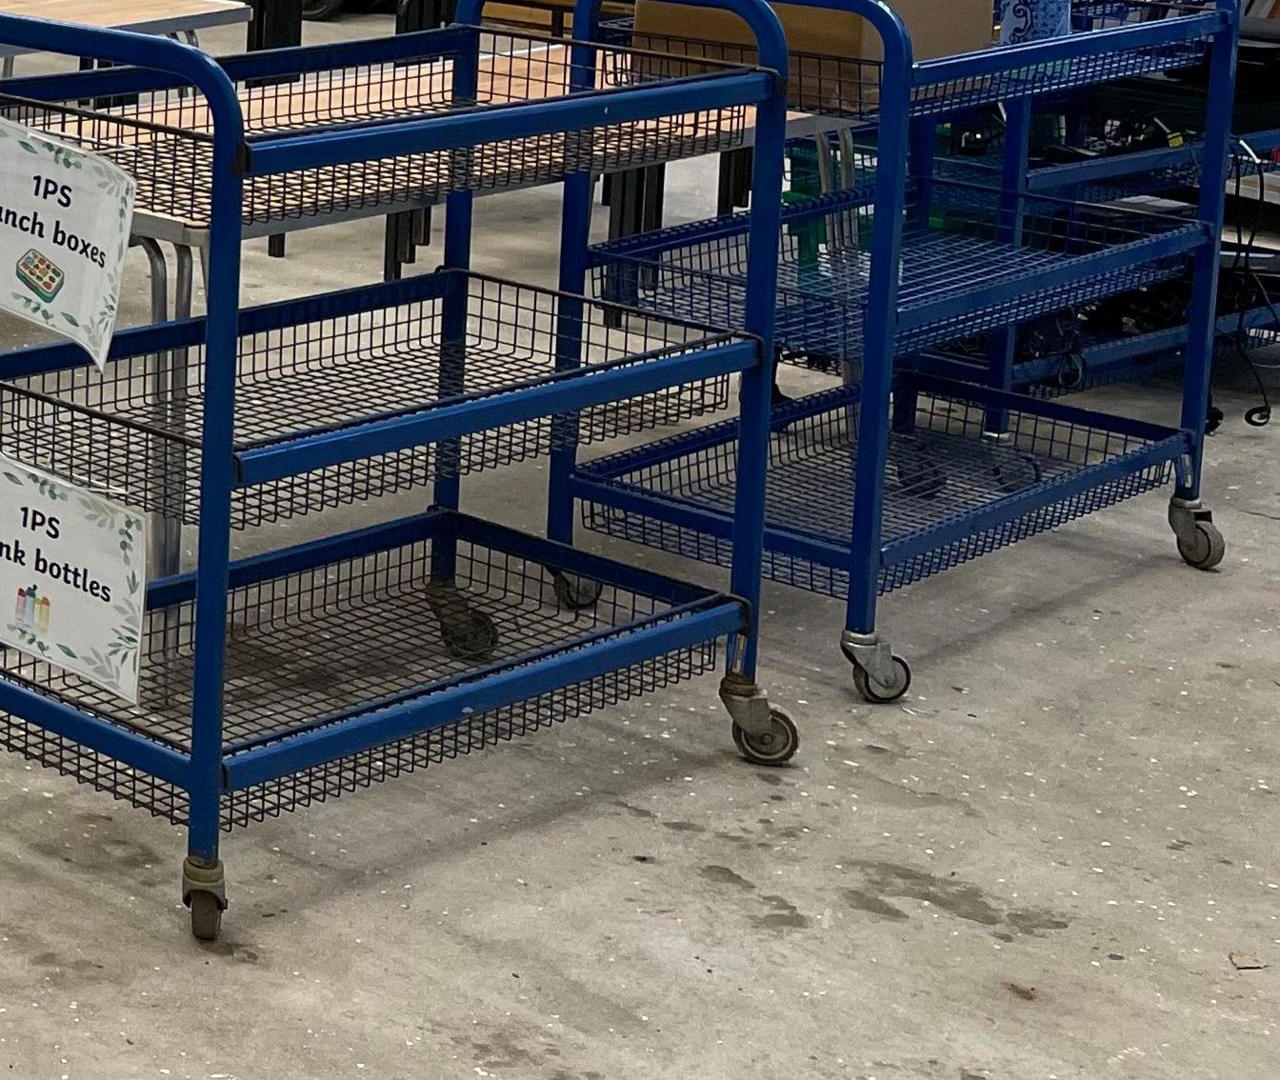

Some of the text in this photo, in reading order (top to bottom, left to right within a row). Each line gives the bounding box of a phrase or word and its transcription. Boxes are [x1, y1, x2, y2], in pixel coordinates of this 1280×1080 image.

[32, 175, 73, 208] 1PS
[52, 220, 107, 268] boxes
[20, 506, 60, 539] 1PS
[34, 548, 111, 602] bottles
